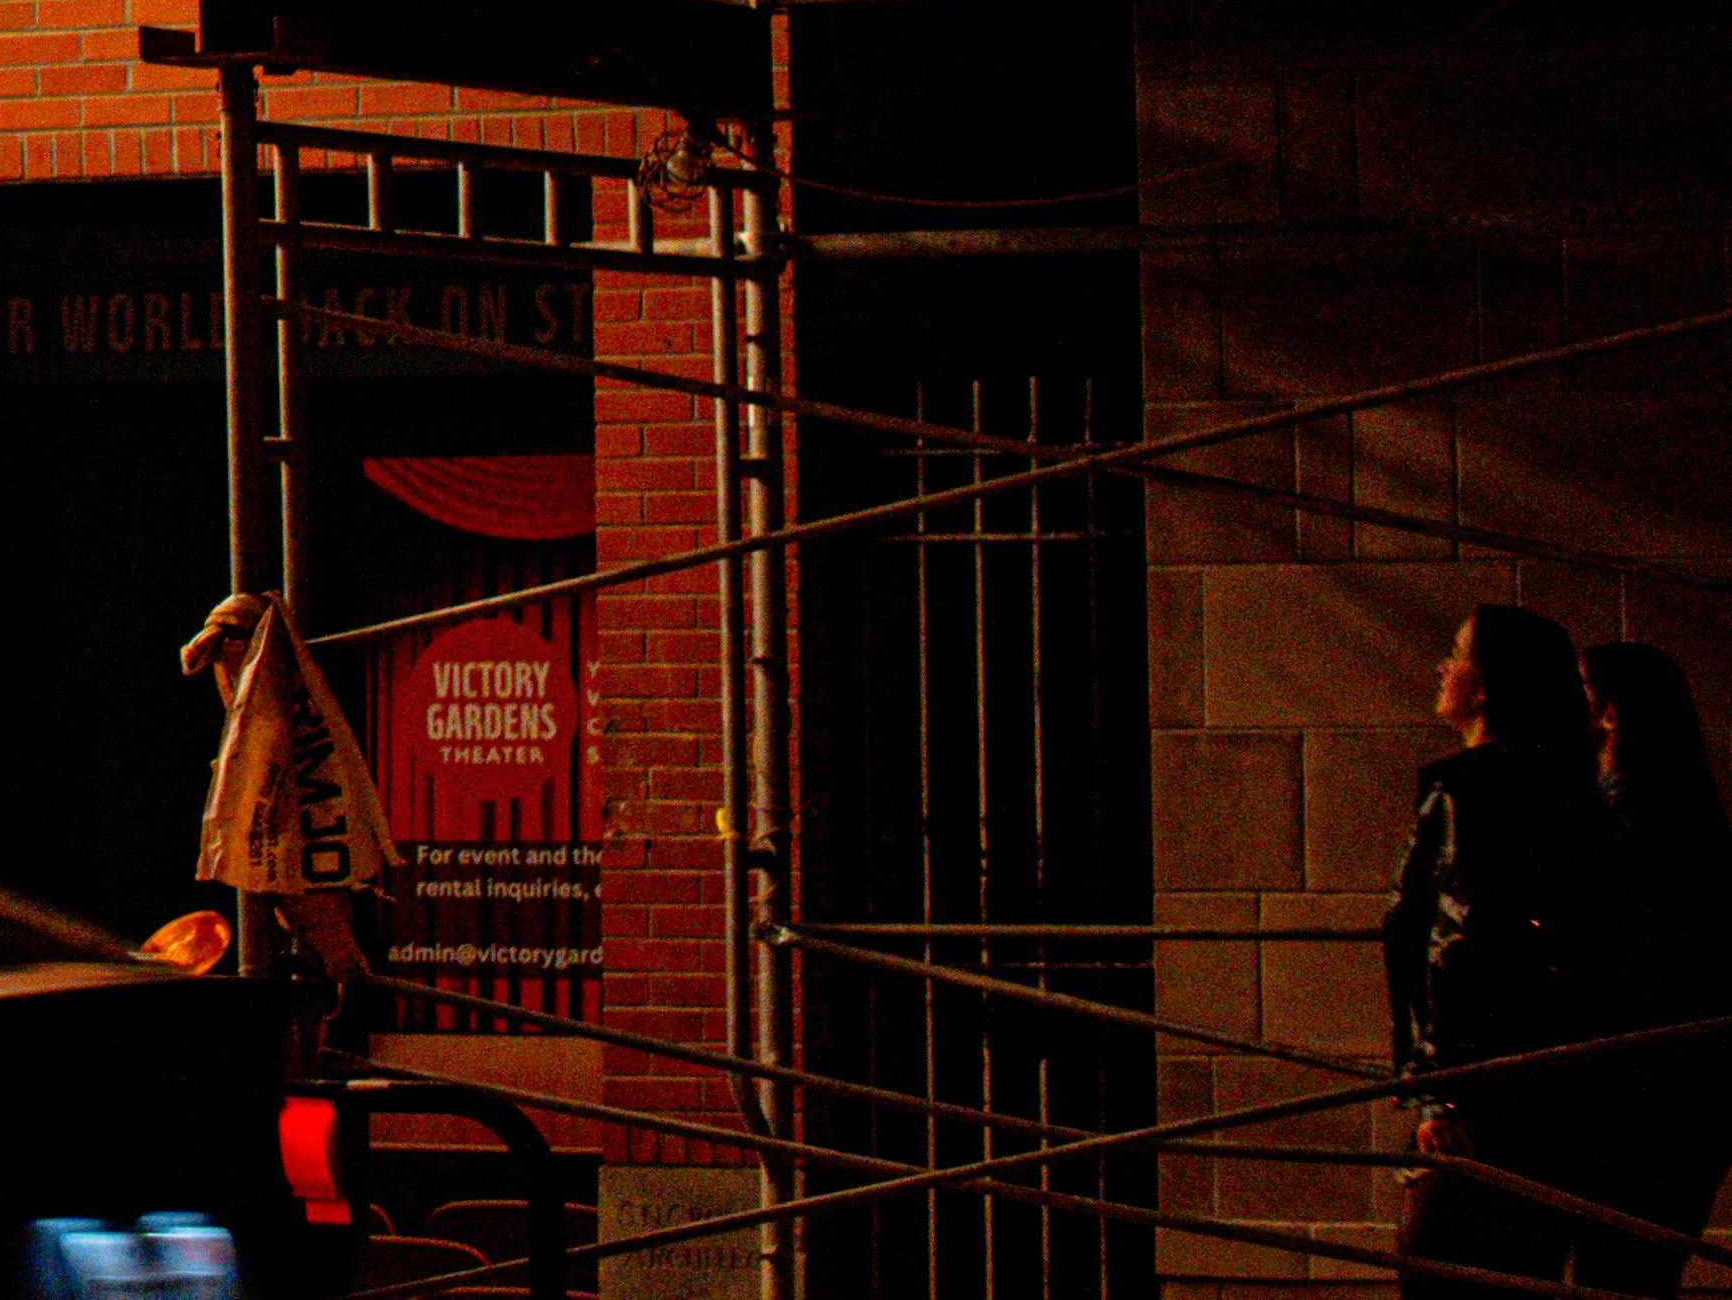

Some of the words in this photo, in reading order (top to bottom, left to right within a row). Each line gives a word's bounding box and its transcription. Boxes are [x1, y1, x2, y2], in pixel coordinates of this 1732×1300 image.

[300, 285, 414, 348] ACK
[441, 284, 508, 344] ON
[432, 660, 552, 700] VICTORY
[425, 702, 558, 742] GARDENS
[438, 746, 545, 765] THEATER
[415, 843, 452, 867] For
[457, 846, 520, 867] event
[525, 844, 567, 867] and
[415, 877, 482, 899] rental
[486, 877, 590, 904] inquiries,
[387, 941, 603, 971] admin@victorygard
